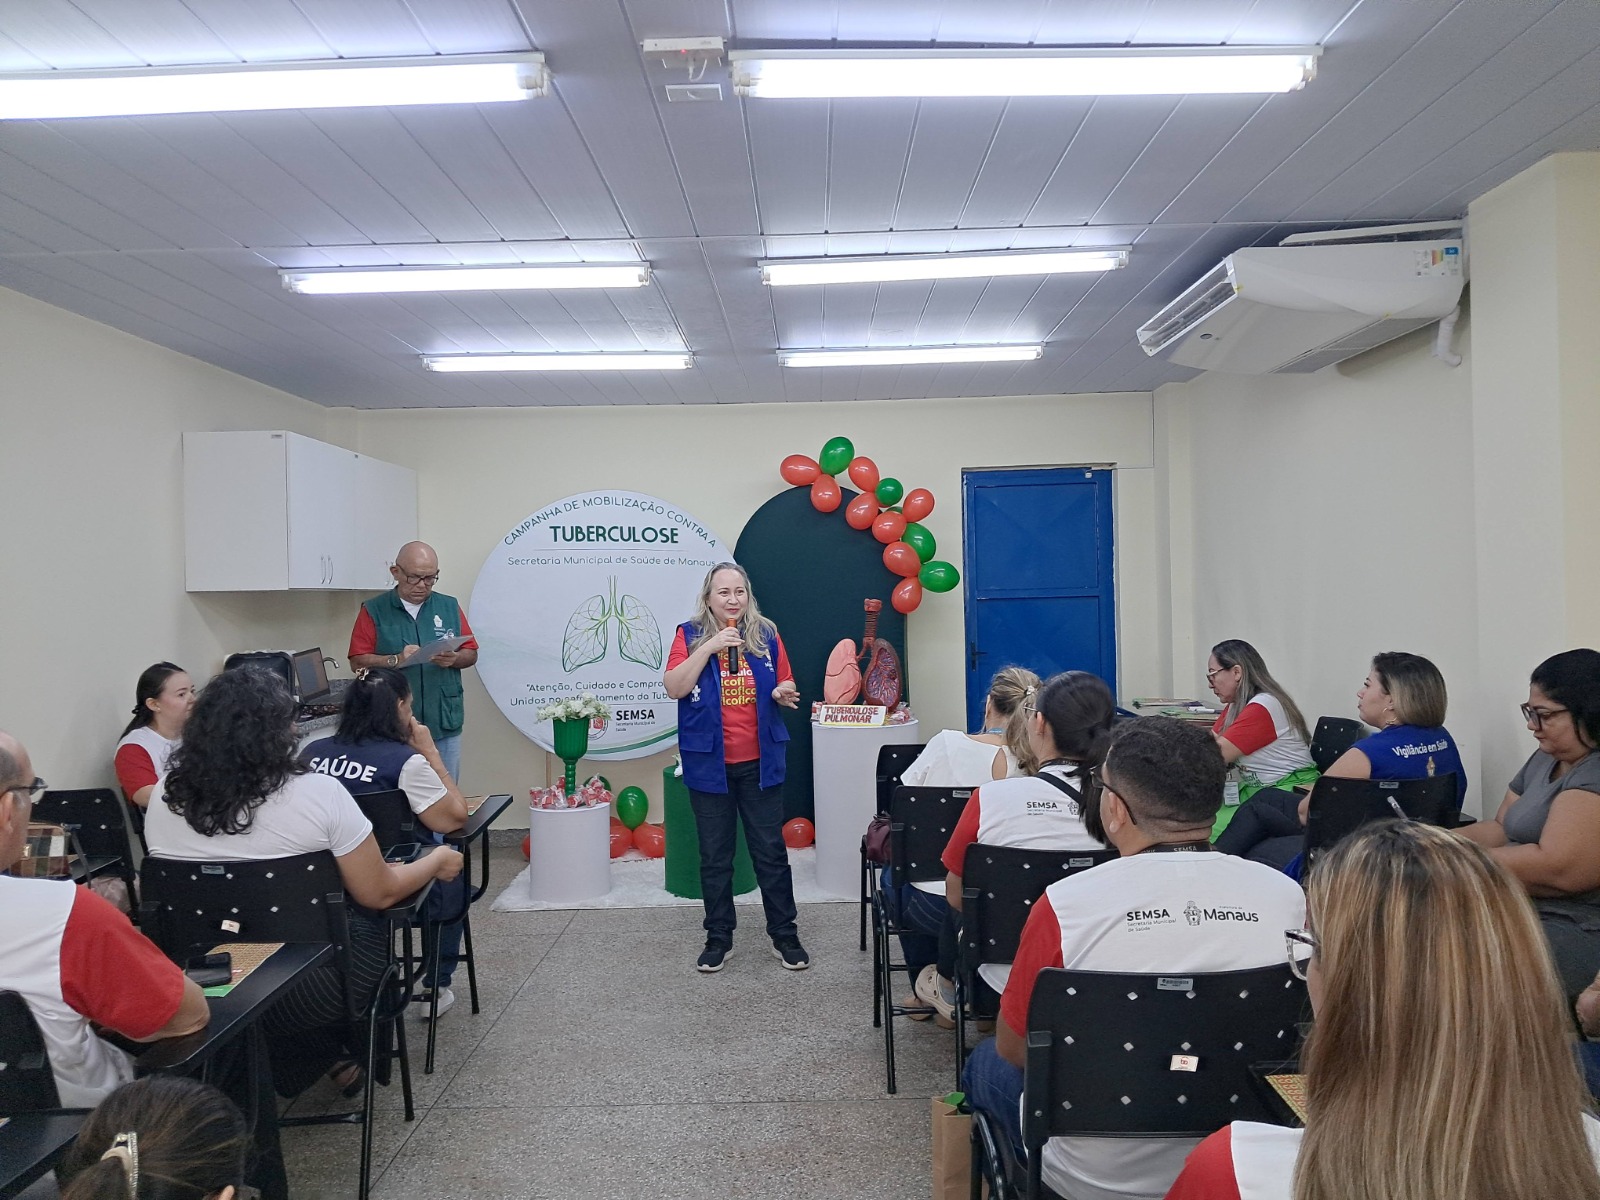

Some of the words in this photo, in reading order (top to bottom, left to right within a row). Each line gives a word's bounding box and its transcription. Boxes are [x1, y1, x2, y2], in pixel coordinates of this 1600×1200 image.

[504, 506, 563, 546] CAMPANHA
[563, 500, 580, 512] DE
[582, 496, 665, 515] MOBILIZAÇÃO
[666, 510, 709, 541] CONTRA
[708, 540, 716, 548] A
[549, 525, 679, 544] TUBERCULOSE
[507, 556, 561, 566] Secretaria
[563, 556, 613, 566] Municipal
[615, 556, 628, 564] de
[630, 556, 661, 565] Saúde
[663, 557, 676, 565] de
[678, 557, 716, 567] Manaus
[575, 681, 617, 690] Cuidado
[627, 680, 664, 690] Compro
[510, 697, 546, 706] Unidos
[637, 692, 649, 700] da
[615, 709, 655, 721] SEMSA
[824, 706, 879, 715] TUBERCULOSE
[824, 714, 872, 723] PULMONAR
[1391, 743, 1428, 759] Vigilância
[1428, 744, 1438, 753] em
[309, 754, 378, 783] SAÚDE
[1026, 801, 1058, 809] SEMSA
[1126, 908, 1171, 921] SEMSA
[1203, 908, 1259, 922] Manaus
